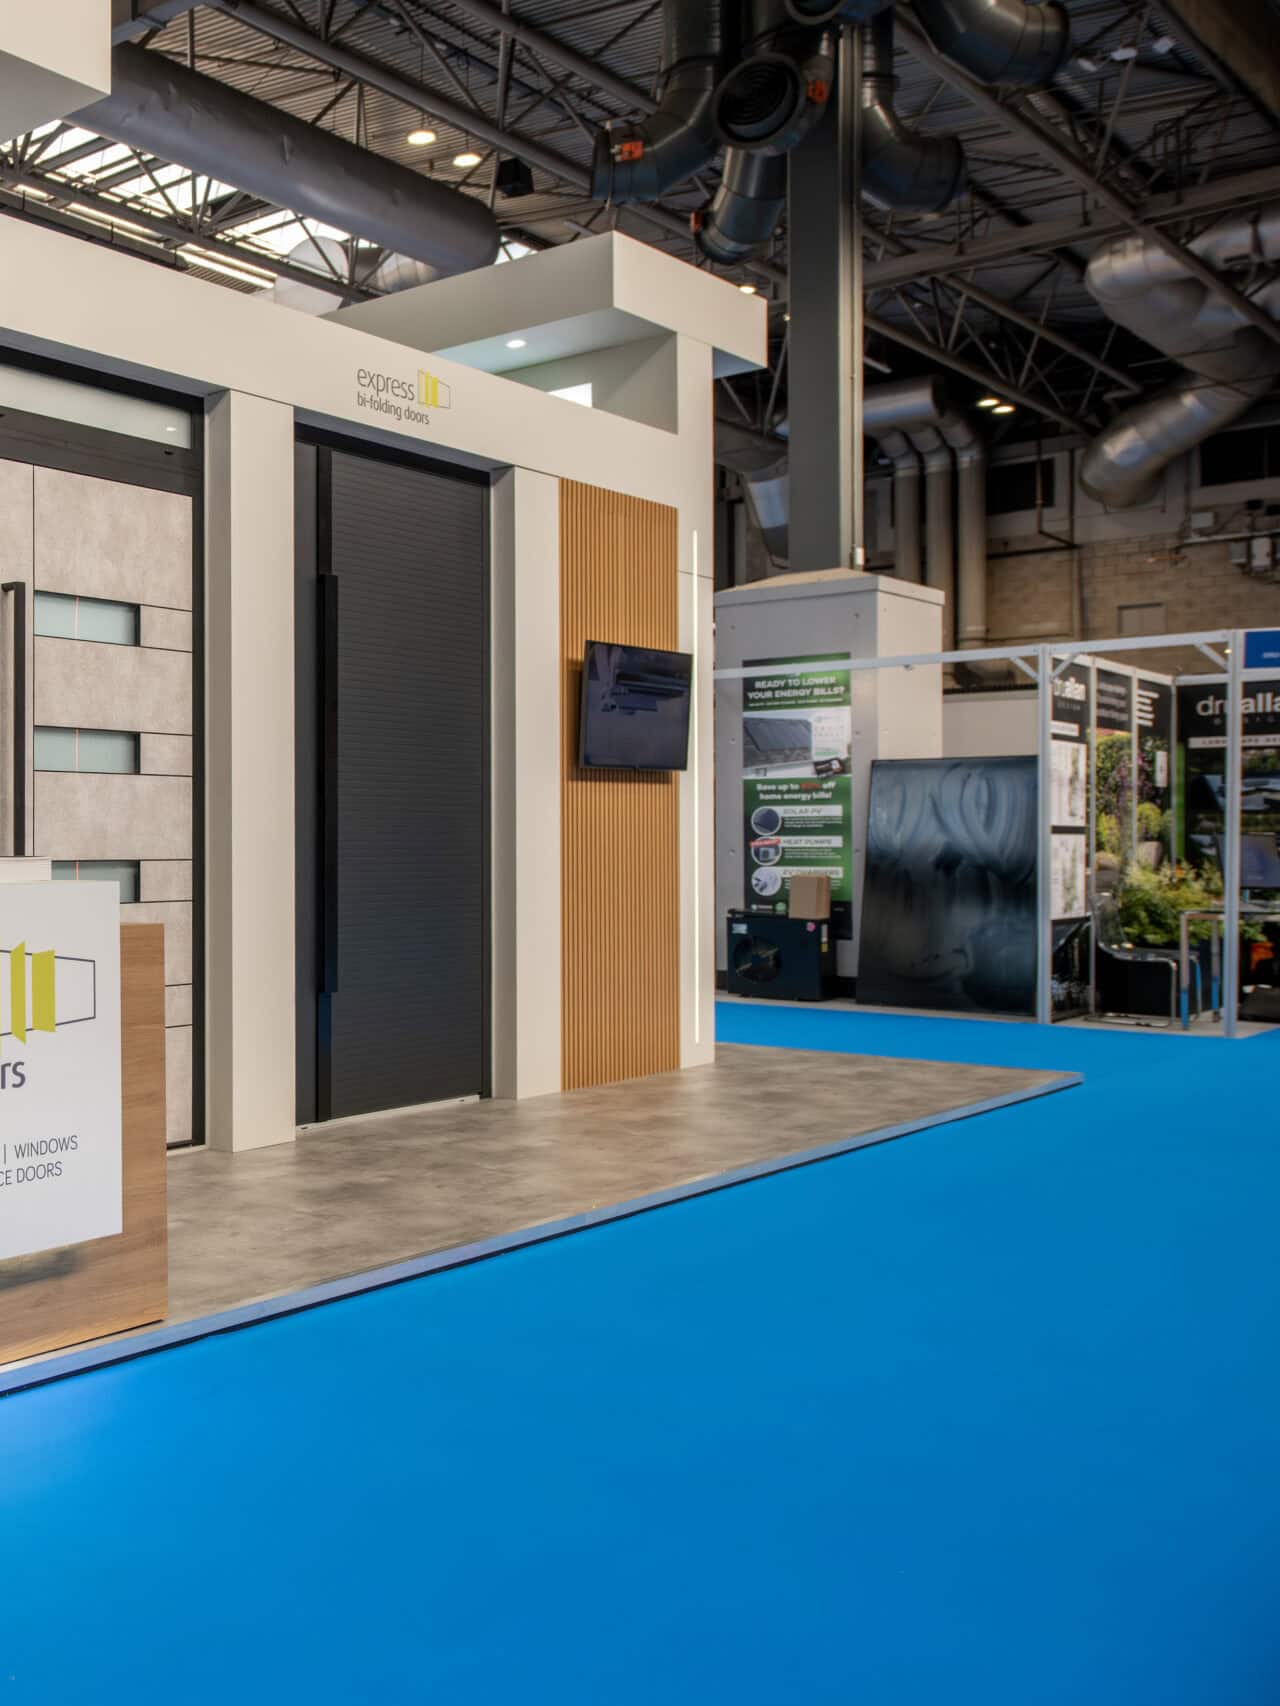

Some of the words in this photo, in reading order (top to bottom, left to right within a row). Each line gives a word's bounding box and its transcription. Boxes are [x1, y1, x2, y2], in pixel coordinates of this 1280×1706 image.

[357, 368, 415, 401] express
[357, 391, 402, 421] bi-folding
[404, 405, 430, 424] doors
[755, 679, 786, 688] READY
[789, 679, 800, 687] TO
[802, 676, 836, 685] LOWER
[747, 690, 773, 700] YOUR
[775, 688, 812, 698] ENERGY
[14, 1134, 78, 1158] WINDOWS
[17, 1161, 63, 1184] DOORS
